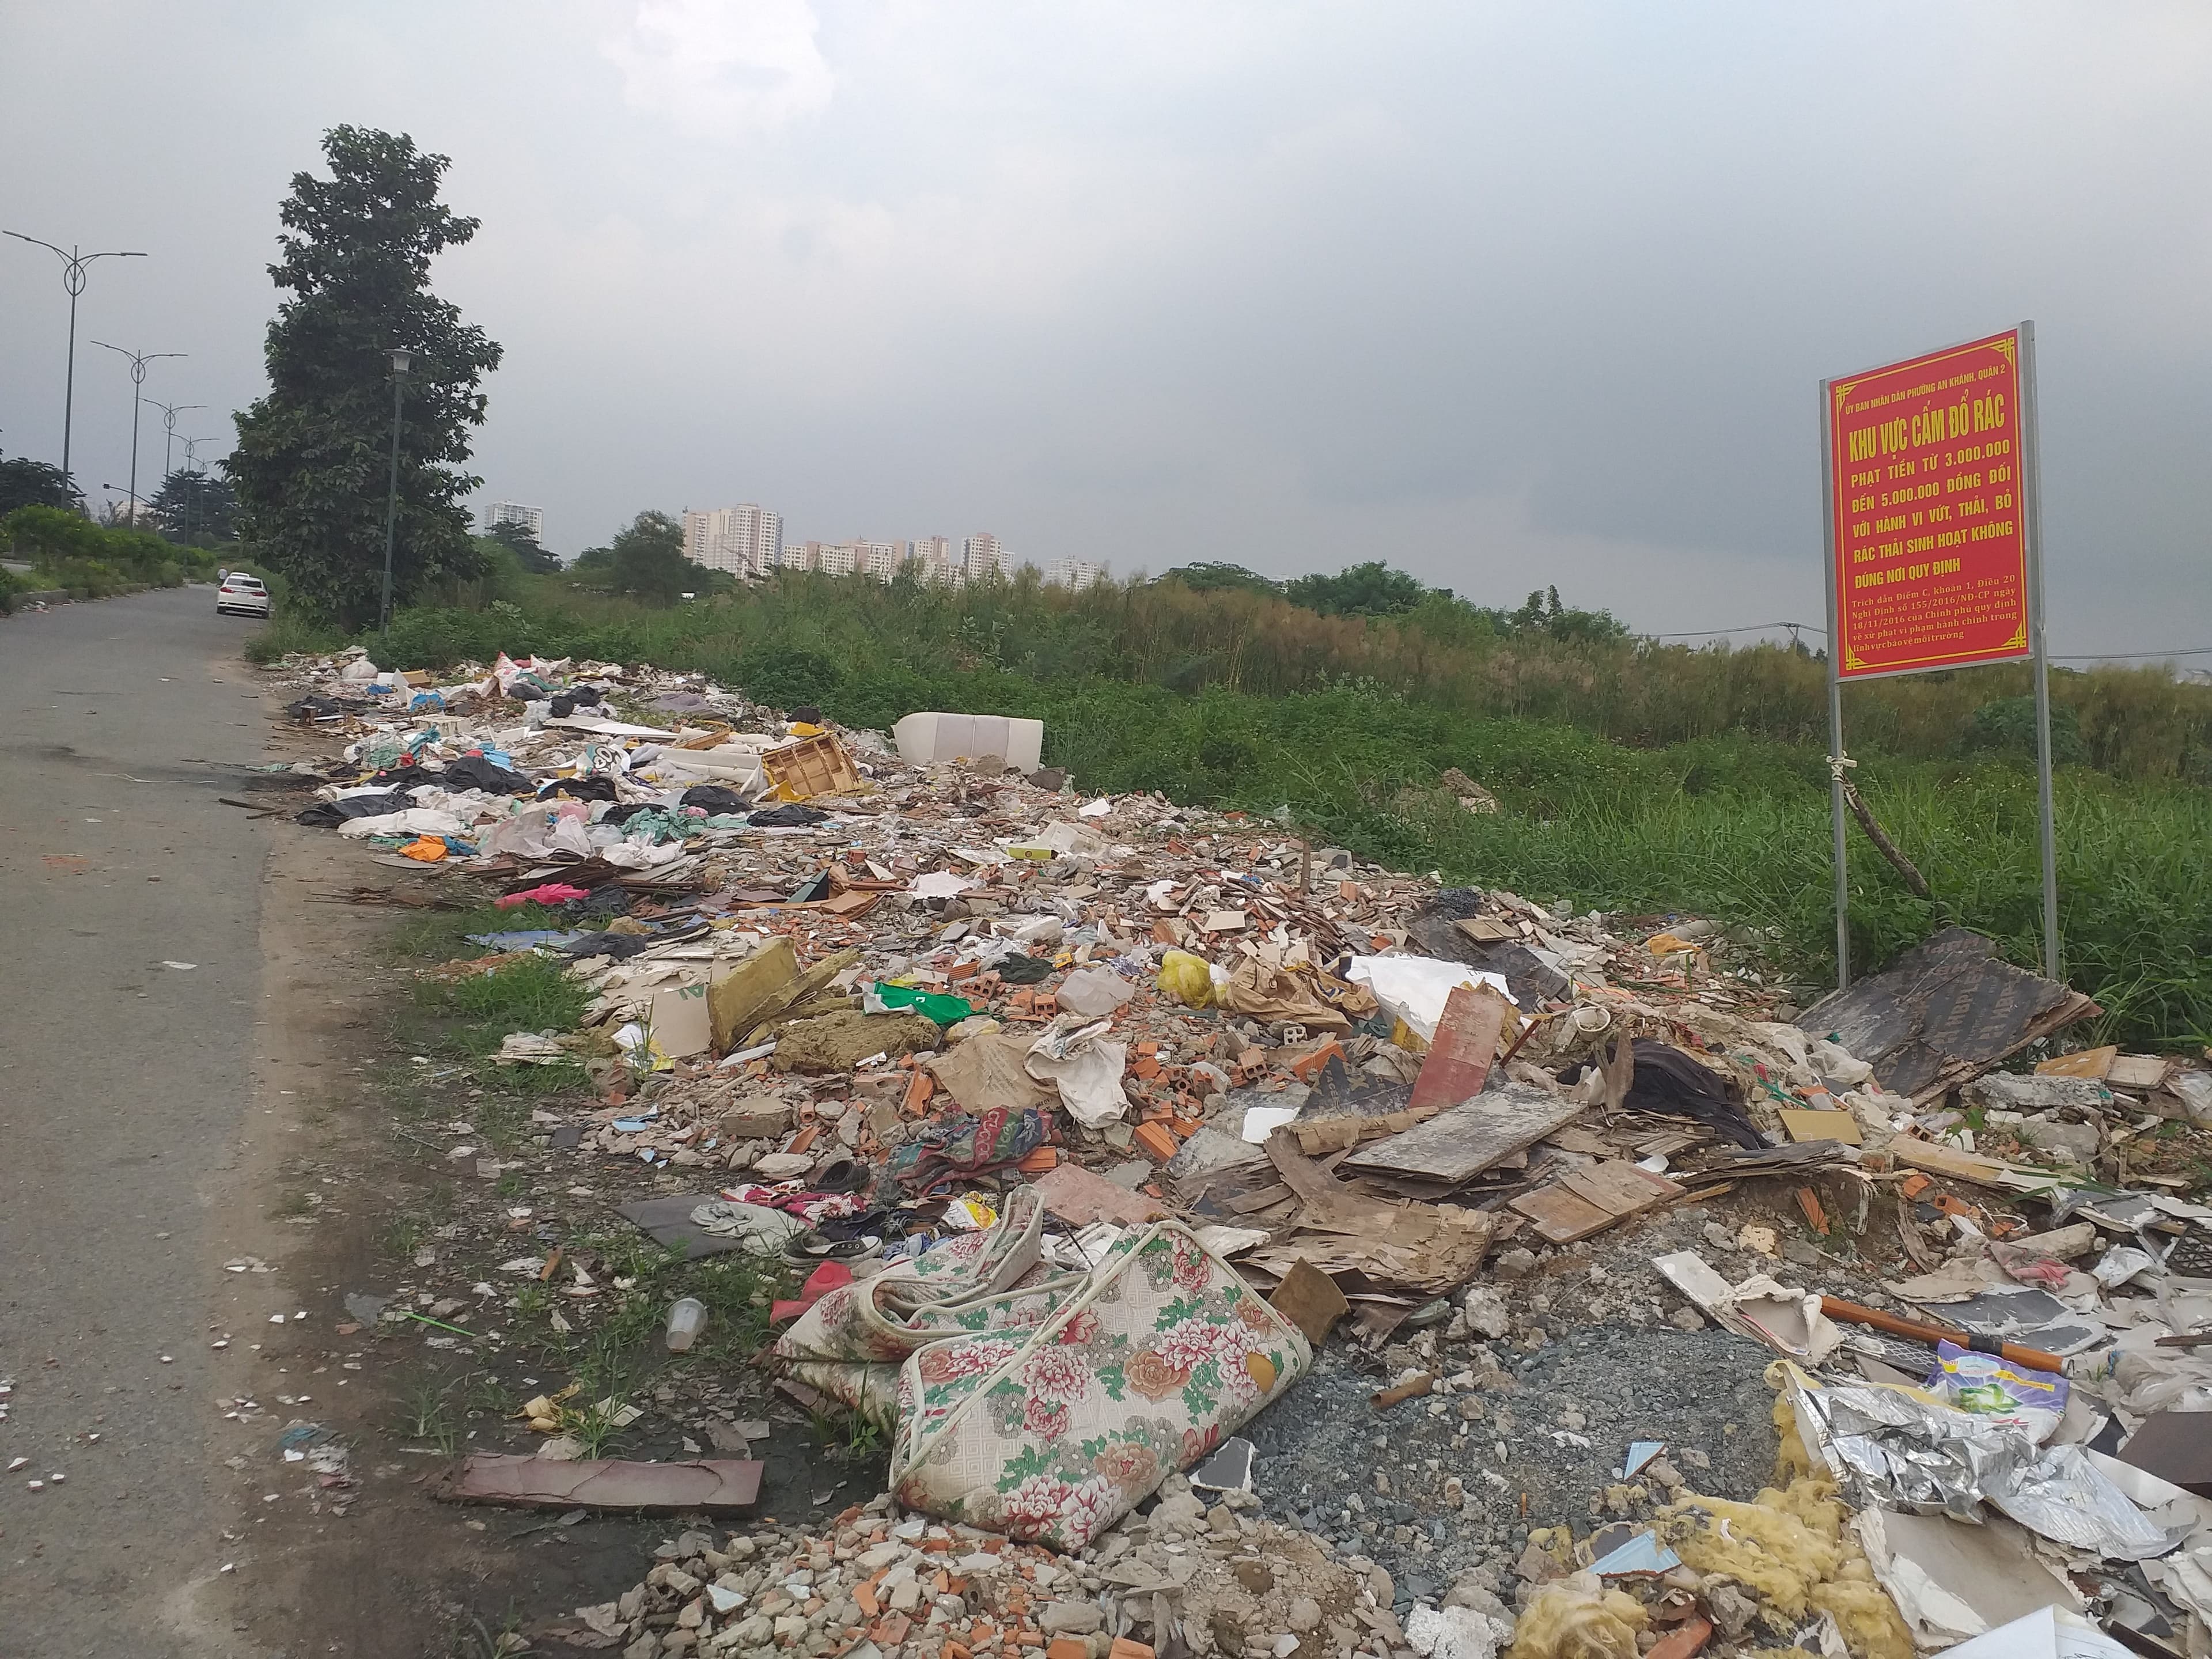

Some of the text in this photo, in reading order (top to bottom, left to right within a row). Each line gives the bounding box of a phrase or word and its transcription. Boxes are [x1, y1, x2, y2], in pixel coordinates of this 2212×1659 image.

[1855, 399, 1869, 413] BAN
[1938, 378, 1948, 390] AN
[1978, 365, 1998, 380] QUẬN
[2000, 364, 2006, 374] 2
[1849, 389, 2005, 462] KHU VỰC CẤM ĐỔ RÁC
[1851, 439, 2010, 488] PHẠT TIỀN TỪ 3.000.000
[1852, 461, 2011, 513] ĐẾN 5.000.000 ĐỒNG ĐỐI
[1853, 488, 2012, 538] VỚI HÀNH VI VỨT, THẢI, BỎ
[1854, 521, 2013, 563] RÁC THẢI SINH HOẠT KHÔNG
[1855, 558, 1960, 589] ĐÚNG NƠI QUY ĐỊNH
[1966, 581, 1974, 590] 1,
[2003, 574, 2015, 584] 20
[1853, 615, 1904, 631] 18/11/2016
[1974, 603, 1991, 615] quy
[1991, 610, 2017, 622] trong
